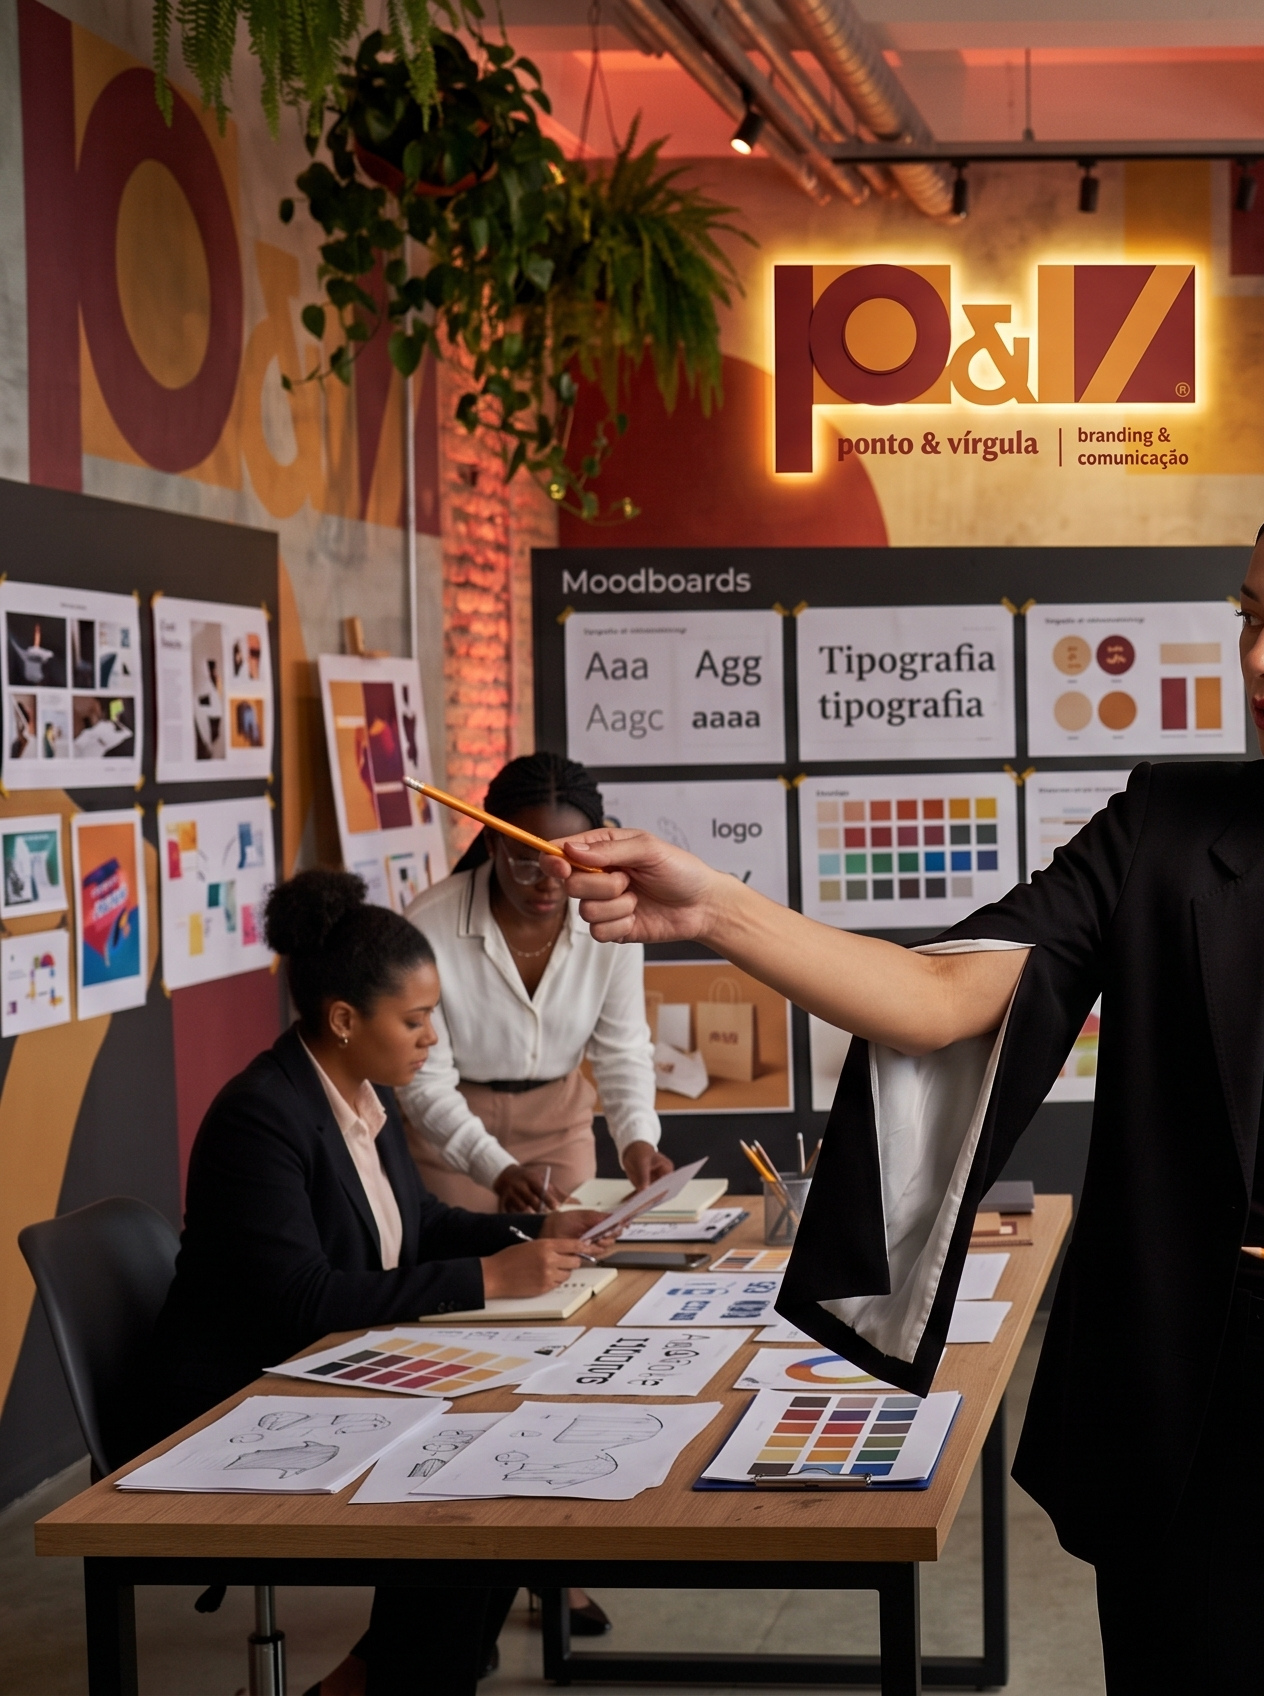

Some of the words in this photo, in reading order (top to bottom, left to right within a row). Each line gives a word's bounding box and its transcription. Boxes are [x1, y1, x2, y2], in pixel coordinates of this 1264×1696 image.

[837, 433, 914, 462] ponto
[920, 431, 942, 455] &
[946, 430, 1040, 462] vírgula
[1077, 427, 1154, 448] branding
[1157, 427, 1171, 443] &
[1077, 448, 1190, 470] comunicação
[561, 566, 752, 595] Moodboards
[585, 650, 649, 681] Aaa
[694, 648, 763, 687] Agg
[818, 642, 997, 683] Tipografia
[585, 702, 665, 740] Aagc
[691, 709, 761, 730] aaaa
[818, 688, 985, 728] tipografia
[711, 818, 763, 844] logo
